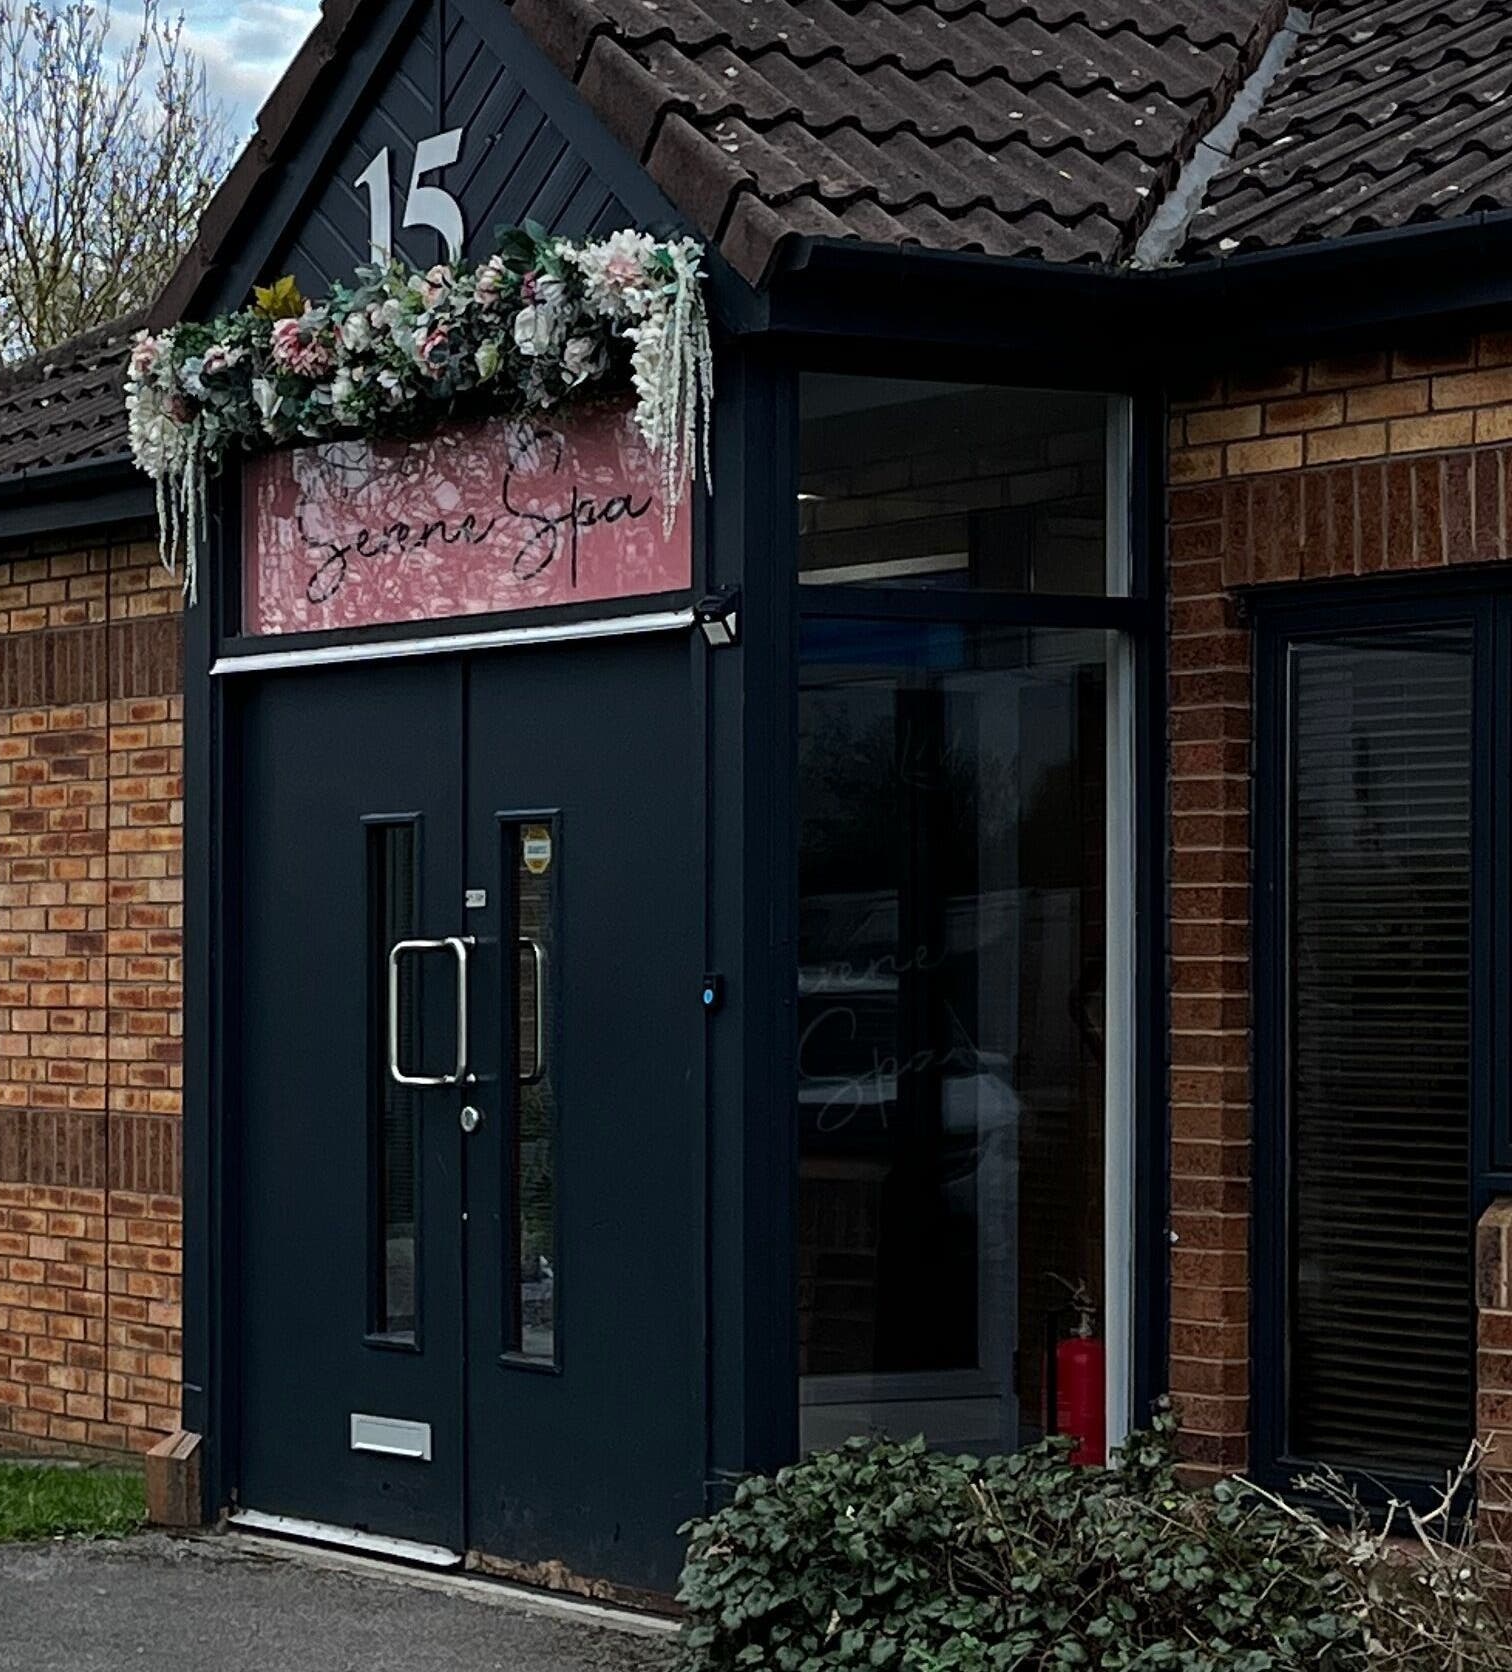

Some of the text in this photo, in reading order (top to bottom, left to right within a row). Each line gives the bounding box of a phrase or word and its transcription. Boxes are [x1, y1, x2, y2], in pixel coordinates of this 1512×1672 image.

[354, 127, 464, 272] 15
[298, 429, 653, 604] Serene Spa
